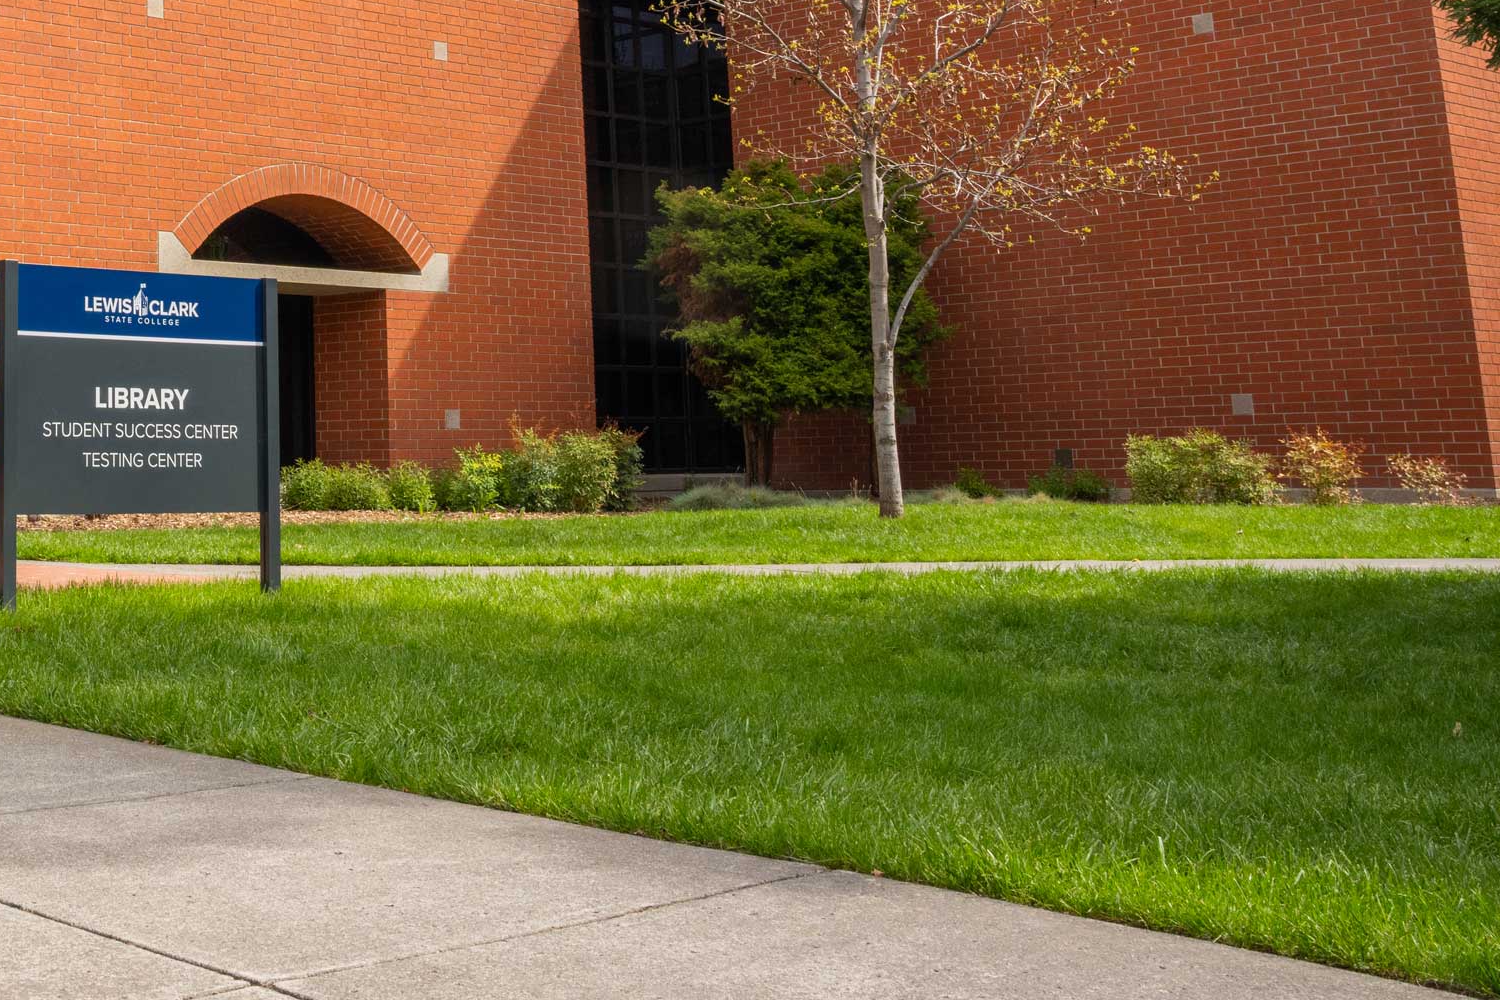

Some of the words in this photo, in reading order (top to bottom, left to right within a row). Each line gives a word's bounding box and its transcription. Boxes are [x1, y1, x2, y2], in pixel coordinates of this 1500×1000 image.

[84, 295, 133, 314] LEWIS
[148, 300, 199, 318] CLARK
[104, 315, 133, 324] STATE
[137, 316, 180, 327] COLLEGE
[95, 386, 190, 410] LIBRARY
[42, 421, 113, 438] STUDENT
[115, 423, 181, 439] SUCCESS
[184, 424, 239, 440] CENTER
[82, 451, 144, 468] TESTING
[147, 452, 203, 469] CENTER
